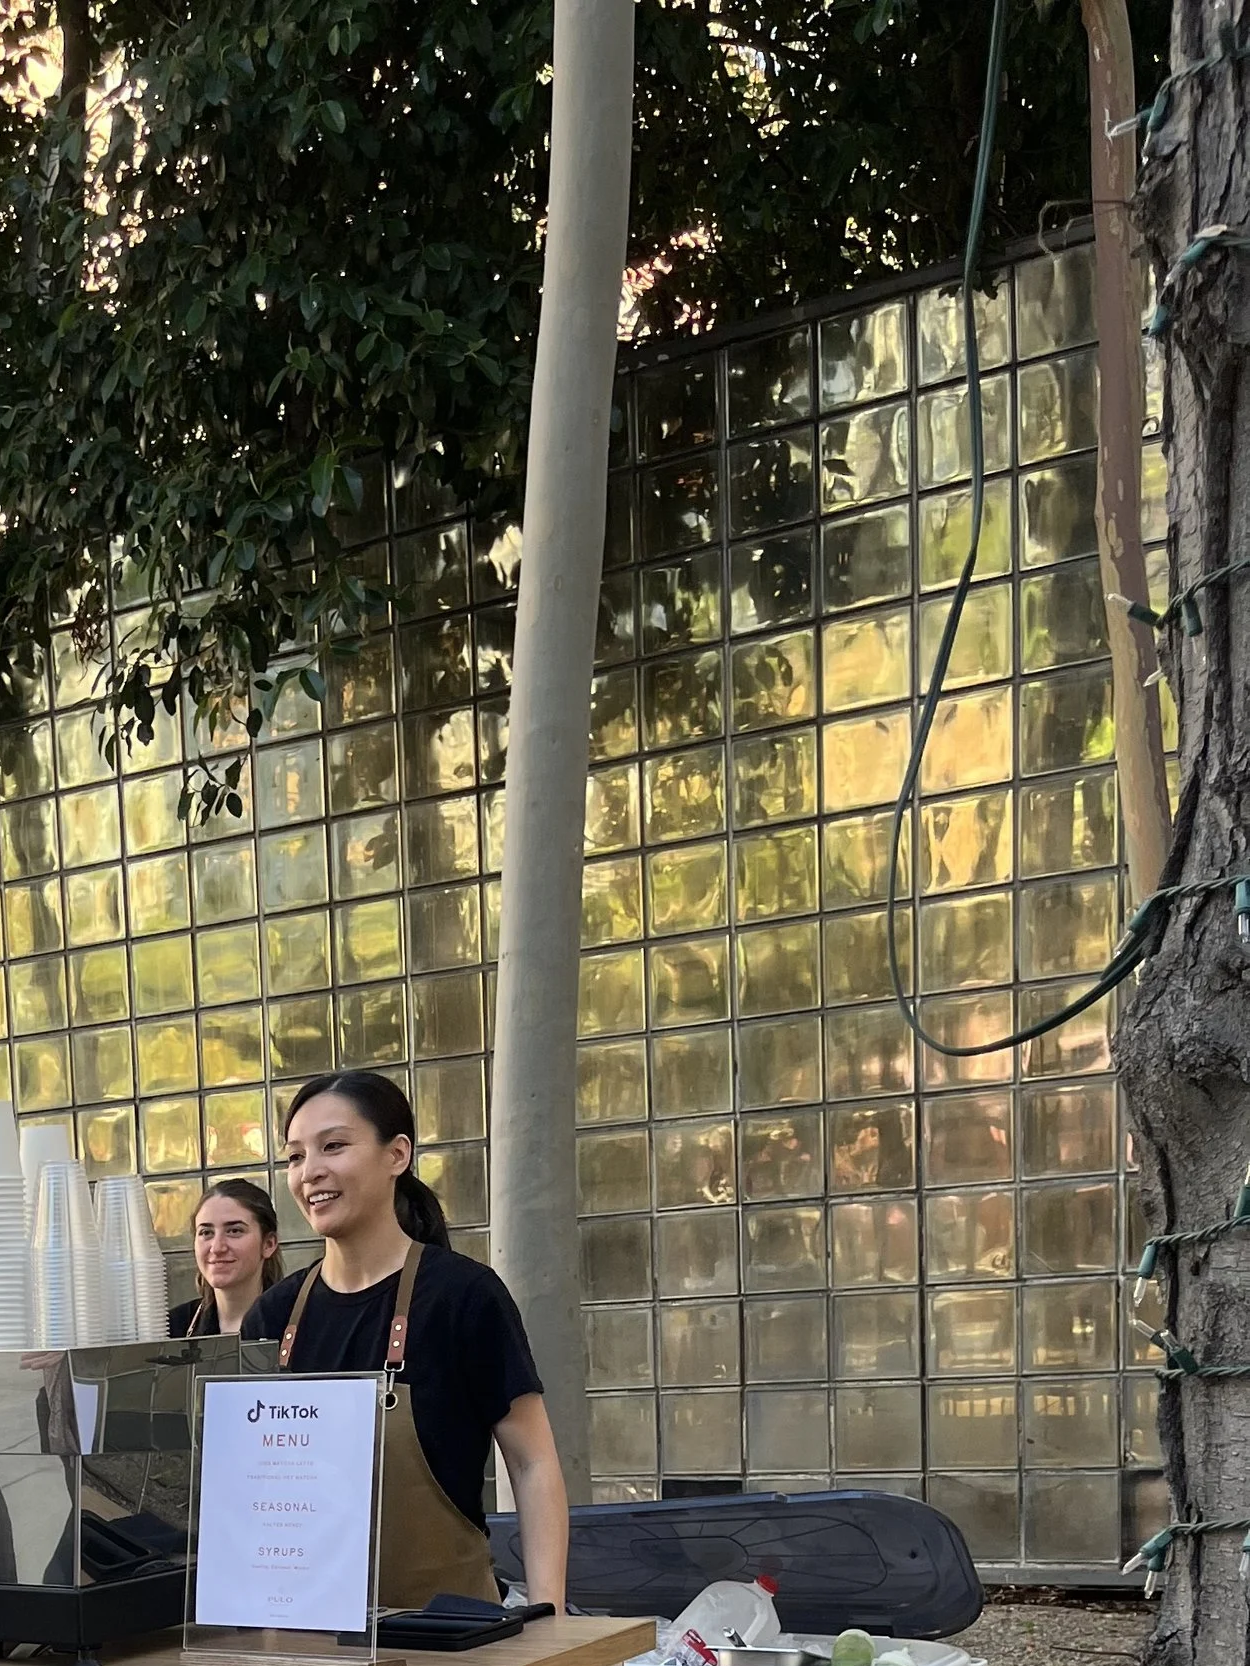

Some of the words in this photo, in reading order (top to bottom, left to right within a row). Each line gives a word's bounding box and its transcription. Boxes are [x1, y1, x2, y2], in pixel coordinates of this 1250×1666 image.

[269, 1405, 319, 1419] TikTok
[262, 1433, 310, 1447] MENU
[252, 1502, 317, 1513] SEASONAL
[258, 1546, 304, 1557] SYRUPS
